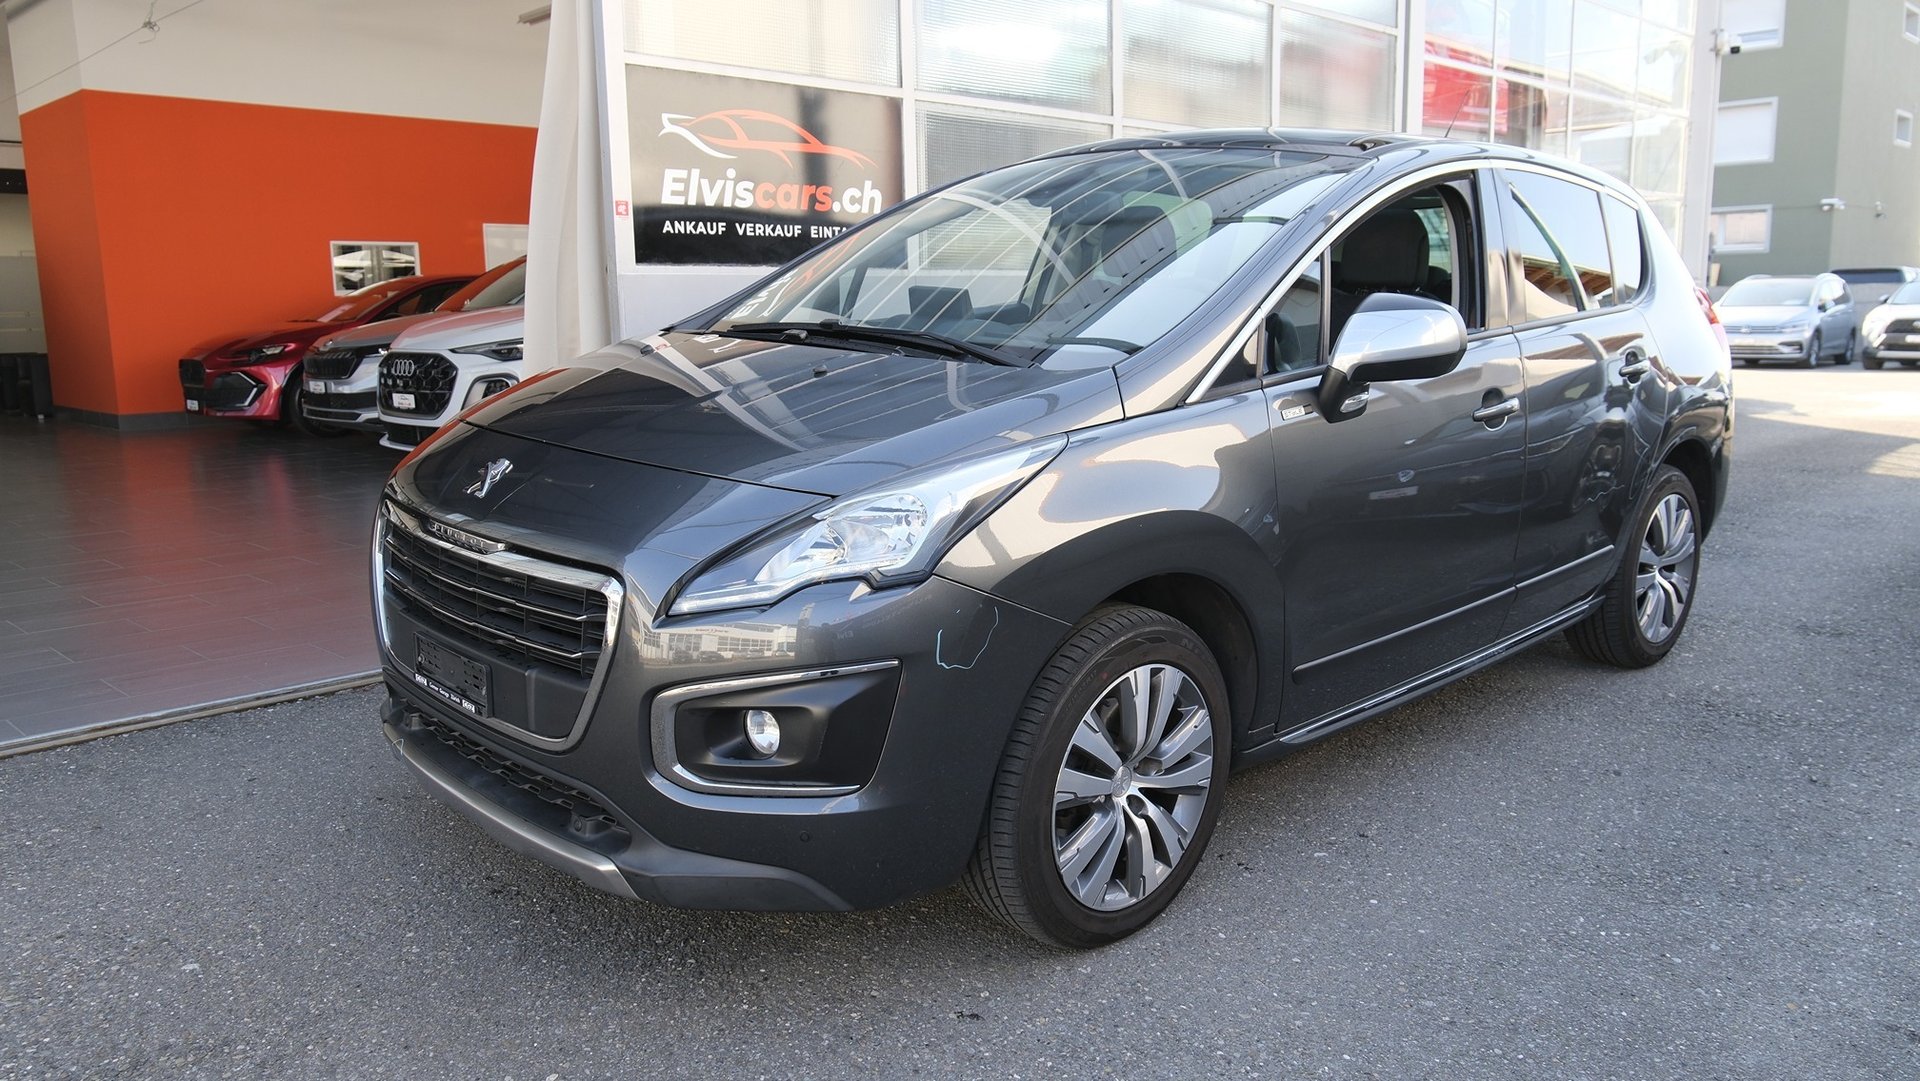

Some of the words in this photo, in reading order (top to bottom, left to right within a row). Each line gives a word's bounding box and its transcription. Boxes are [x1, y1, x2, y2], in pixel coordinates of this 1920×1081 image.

[660, 168, 883, 214] Elviscars.ch
[662, 220, 727, 236] ANKAUF
[735, 222, 803, 238] VERKAUF
